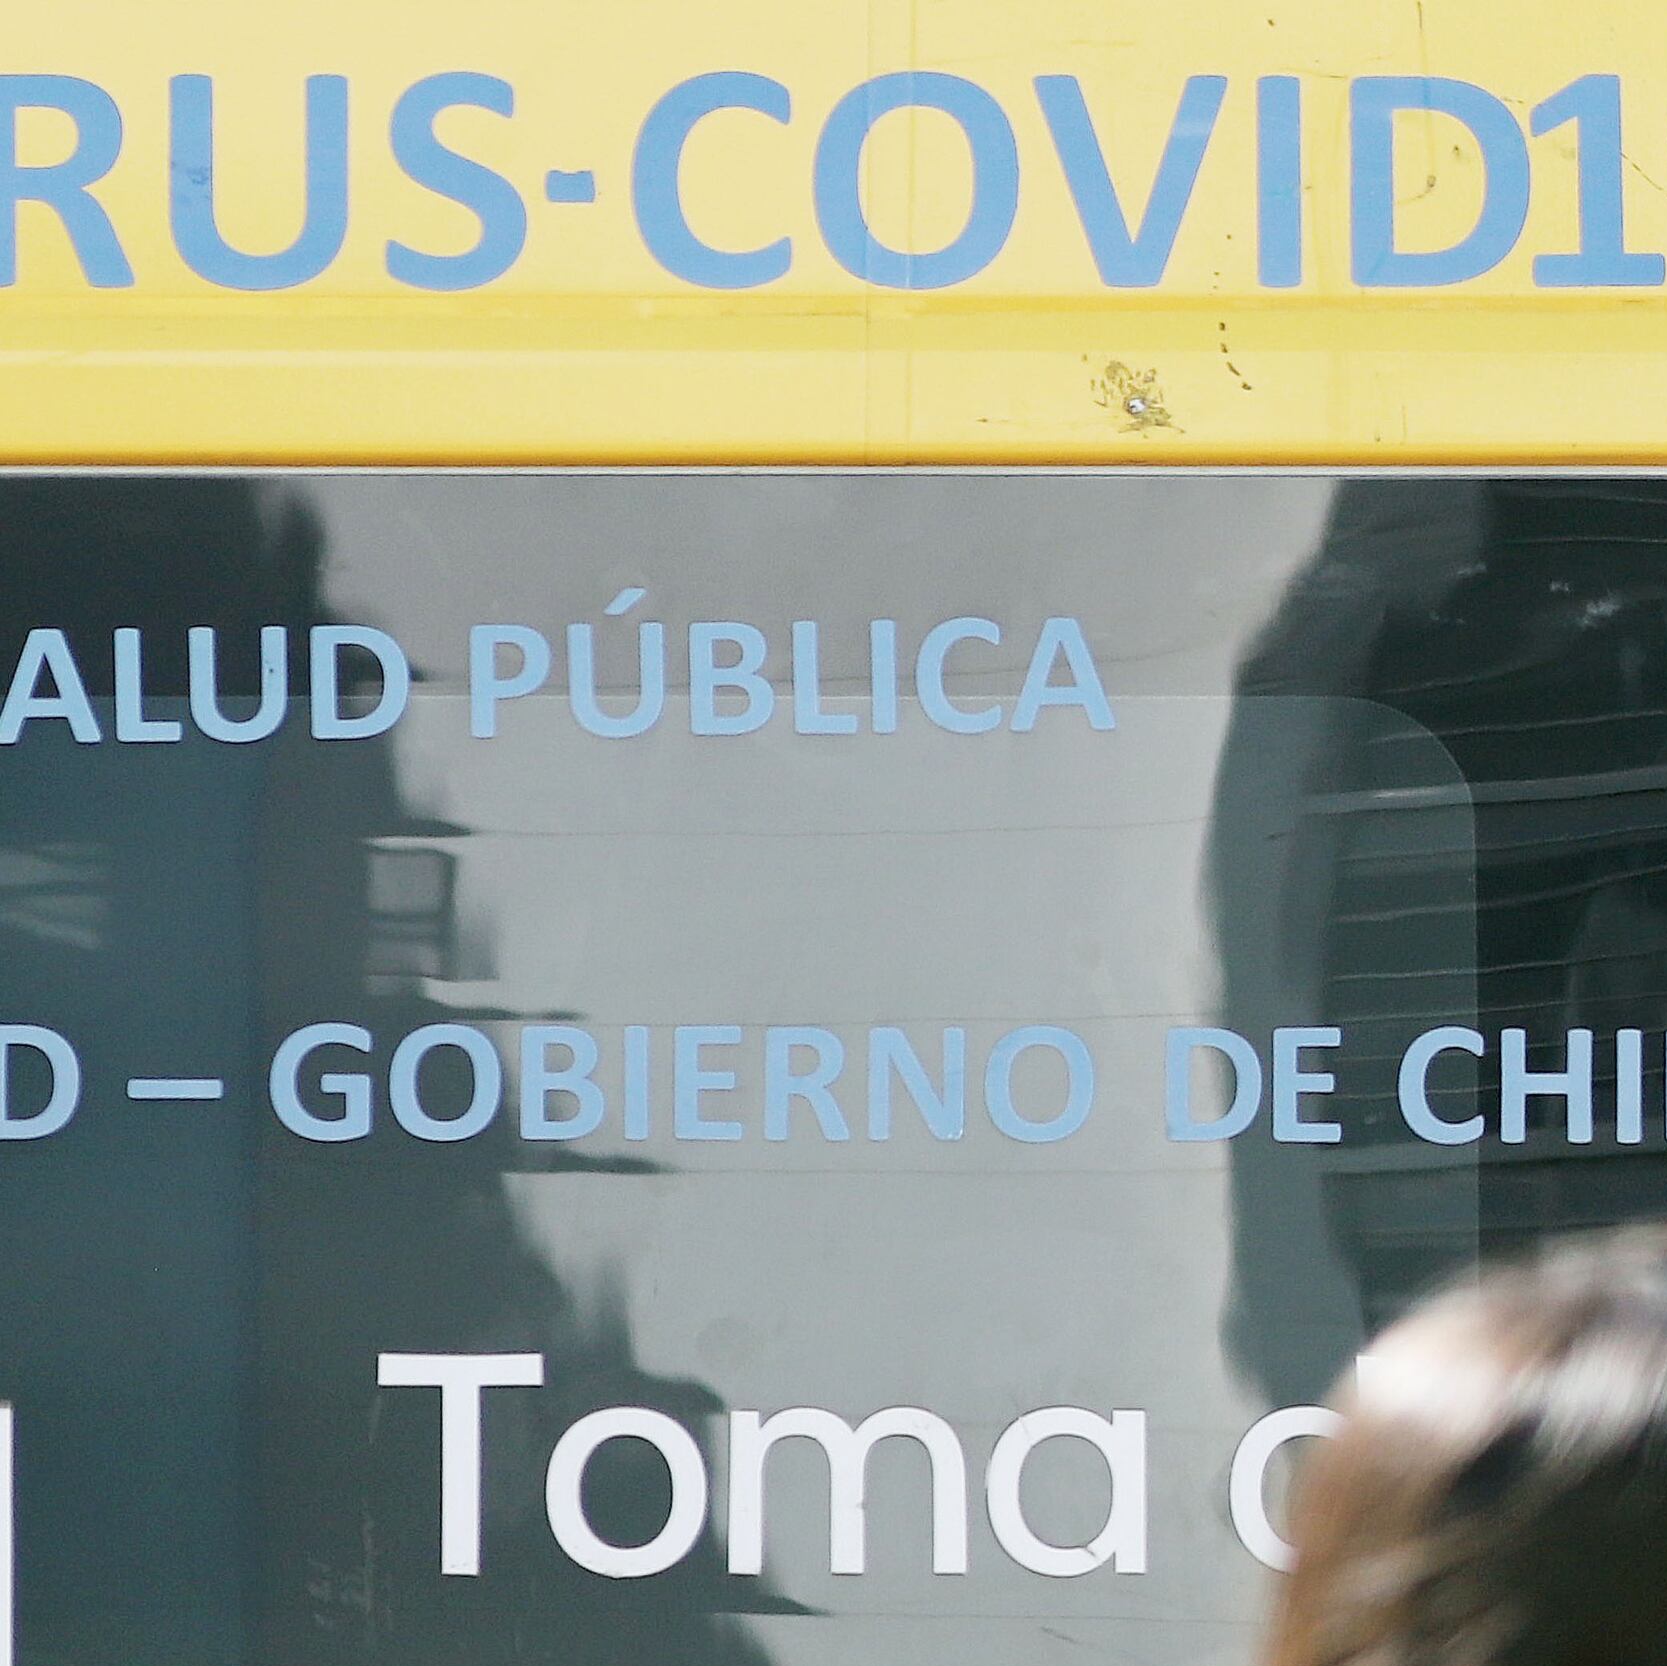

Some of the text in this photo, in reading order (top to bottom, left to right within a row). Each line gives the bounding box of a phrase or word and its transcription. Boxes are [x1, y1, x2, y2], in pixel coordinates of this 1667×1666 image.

[469, 587, 1117, 740] PÚBLICA
[269, 1022, 1095, 1142] GOBIERNO
[1164, 1026, 1342, 1143] DE
[377, 1353, 1147, 1579] Toma
